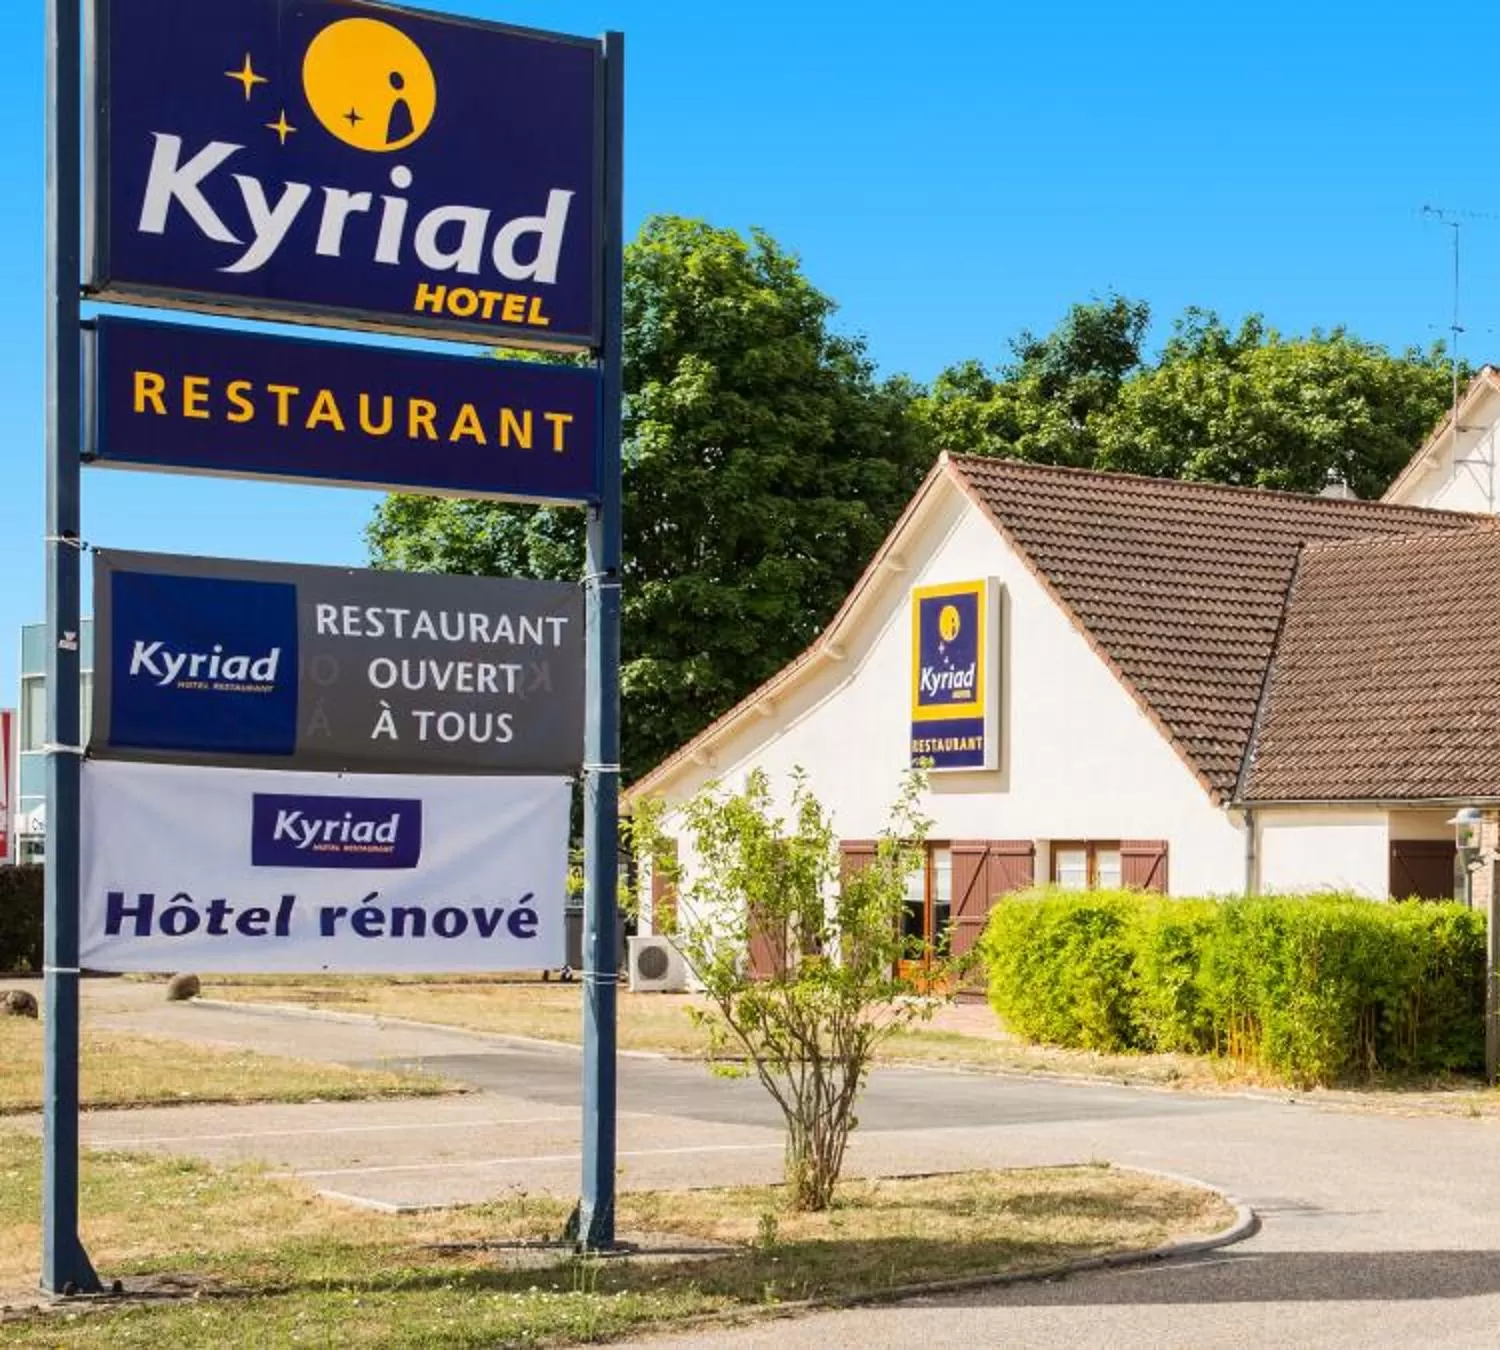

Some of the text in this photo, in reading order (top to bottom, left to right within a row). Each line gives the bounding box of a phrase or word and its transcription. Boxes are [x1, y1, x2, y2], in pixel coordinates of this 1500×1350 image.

[138, 131, 576, 284] Kyriad
[413, 284, 550, 326] HOTEL
[132, 370, 574, 453] RESTAURANT
[316, 603, 569, 647] RESTAURANT
[129, 639, 281, 687] Kyriad
[368, 657, 521, 694] OUVERT
[920, 662, 975, 697] Kyriad
[371, 700, 513, 743] À TOUS
[912, 736, 983, 753] RESTAURANT
[273, 809, 400, 849] Kyriad
[104, 891, 538, 939] Hôtel rénové
